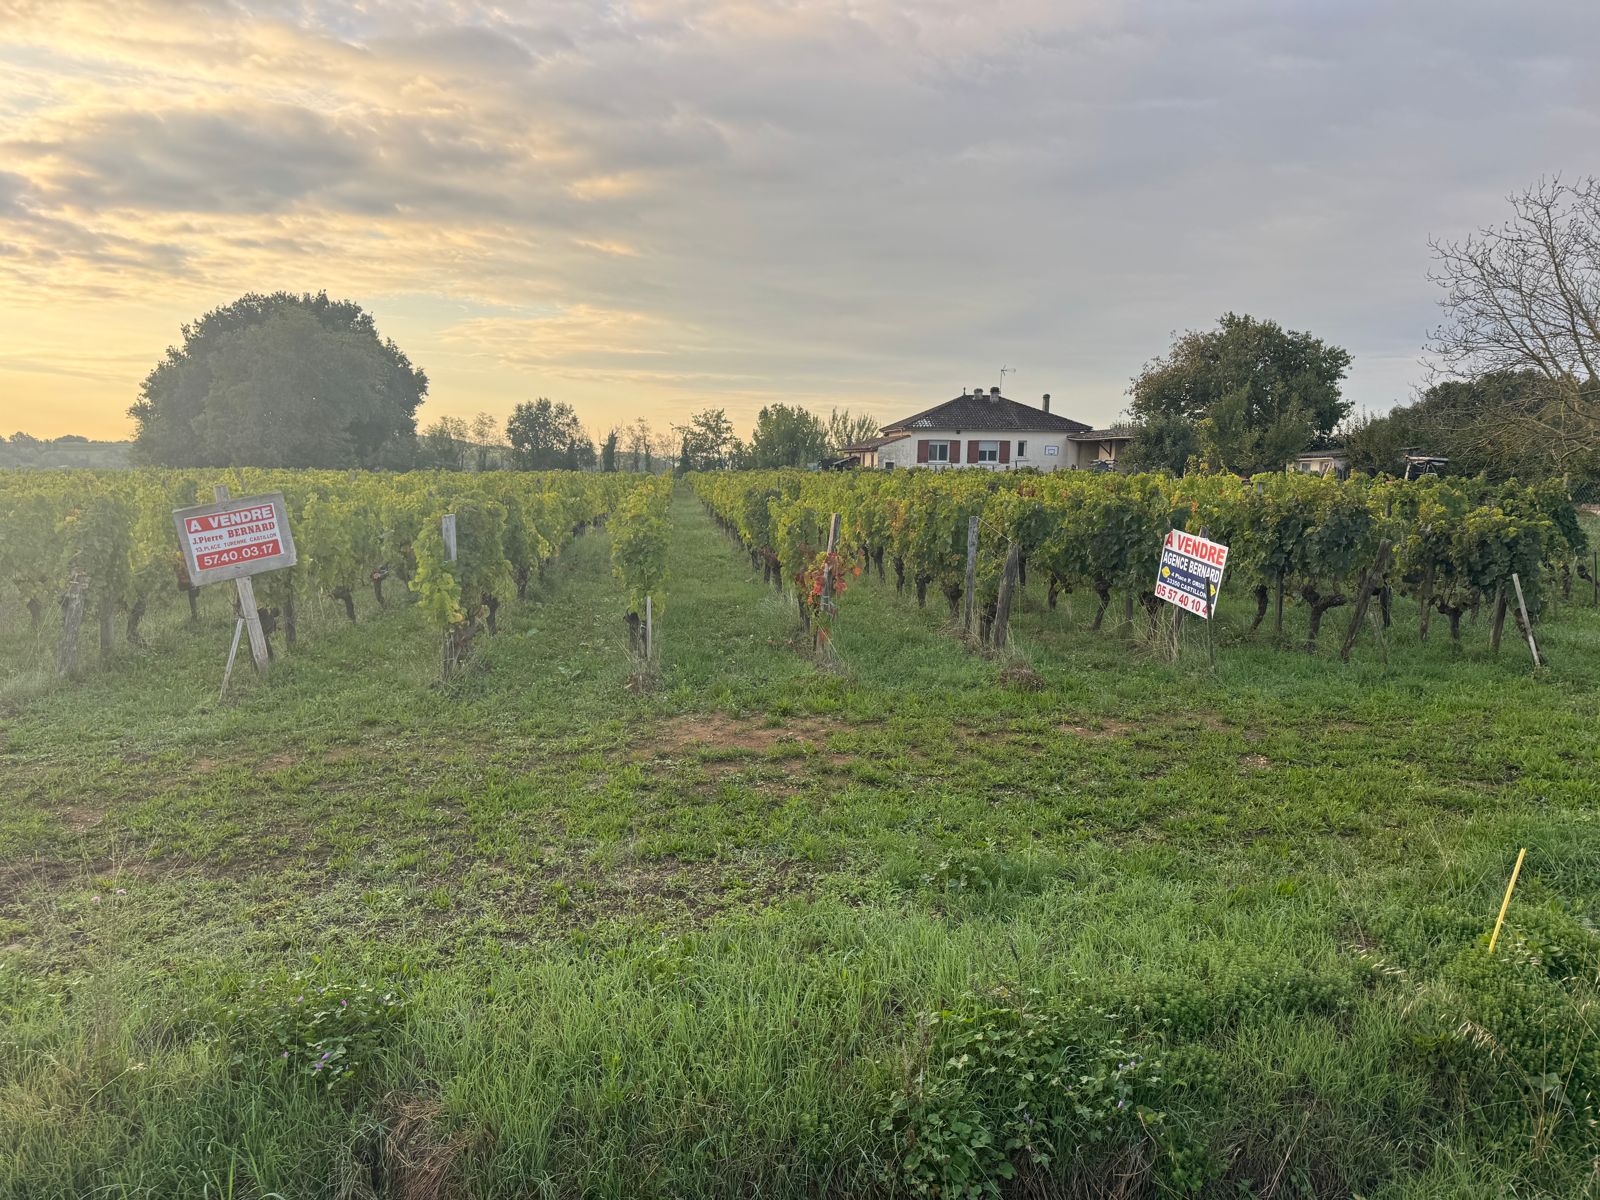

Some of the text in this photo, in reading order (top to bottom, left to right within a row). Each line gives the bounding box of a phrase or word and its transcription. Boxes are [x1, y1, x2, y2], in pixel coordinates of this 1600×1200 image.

[190, 507, 272, 532] A VENDRE
[228, 522, 275, 538] BERNARD
[250, 533, 276, 542] CASTILLON
[1166, 531, 1225, 566] A VENDRE
[204, 544, 274, 566] 57.40.03.17
[1163, 551, 1220, 582] AGENCE BERNARD
[1157, 584, 1166, 596] 05
[1168, 589, 1178, 601] 57
[1179, 594, 1188, 606] 40
[1192, 599, 1200, 611] 10
[1181, 584, 1206, 598] CASTILLON
